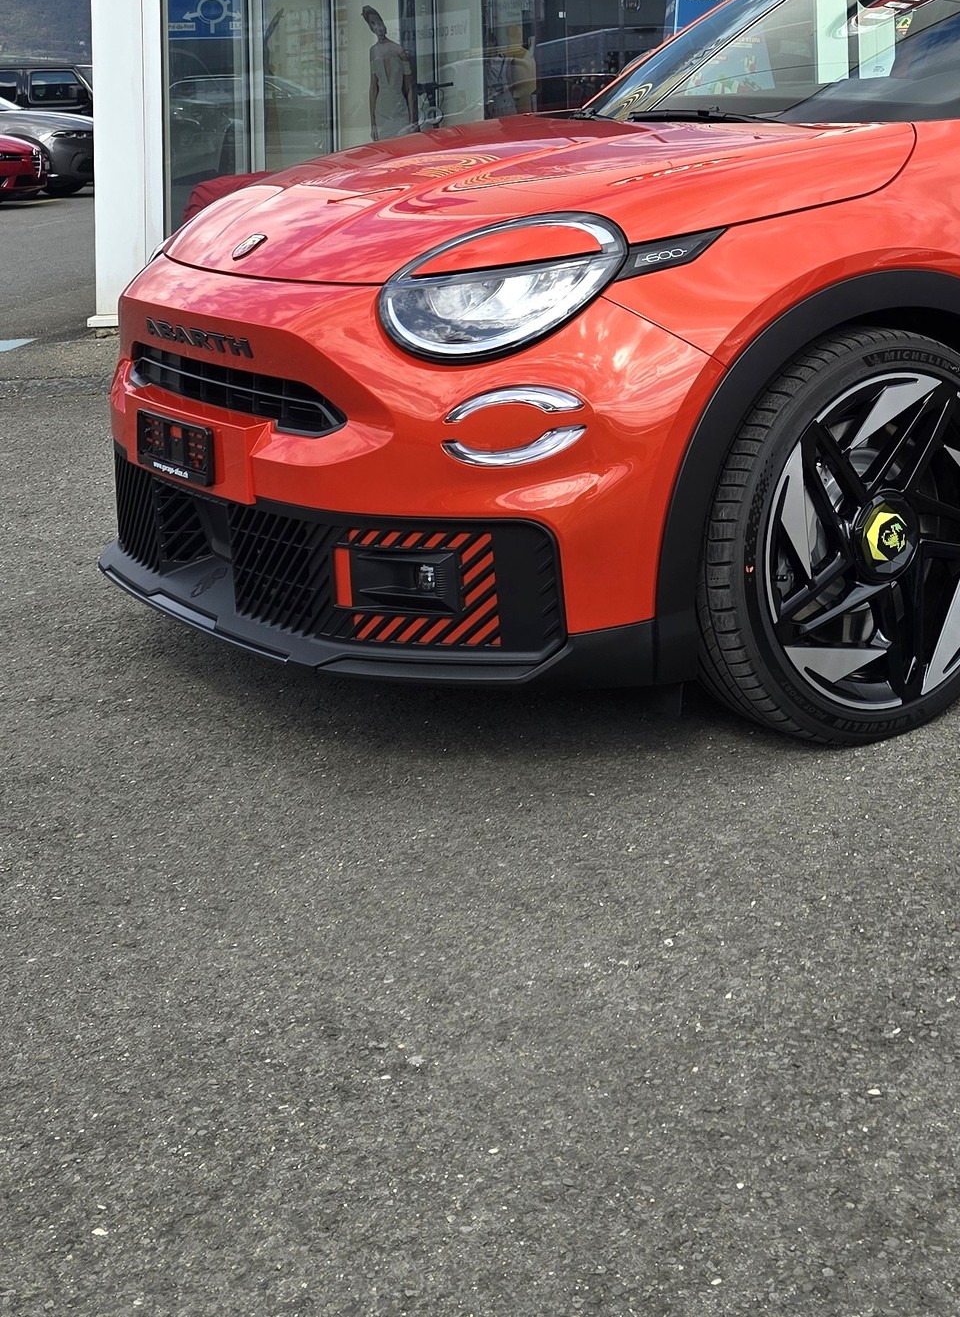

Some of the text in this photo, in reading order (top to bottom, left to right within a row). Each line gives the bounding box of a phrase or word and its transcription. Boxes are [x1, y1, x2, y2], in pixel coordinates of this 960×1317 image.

[644, 248, 686, 263] 600
[145, 316, 254, 359] ABARTH
[883, 349, 950, 371] MICHELIN
[832, 715, 908, 733] MICHELIN
